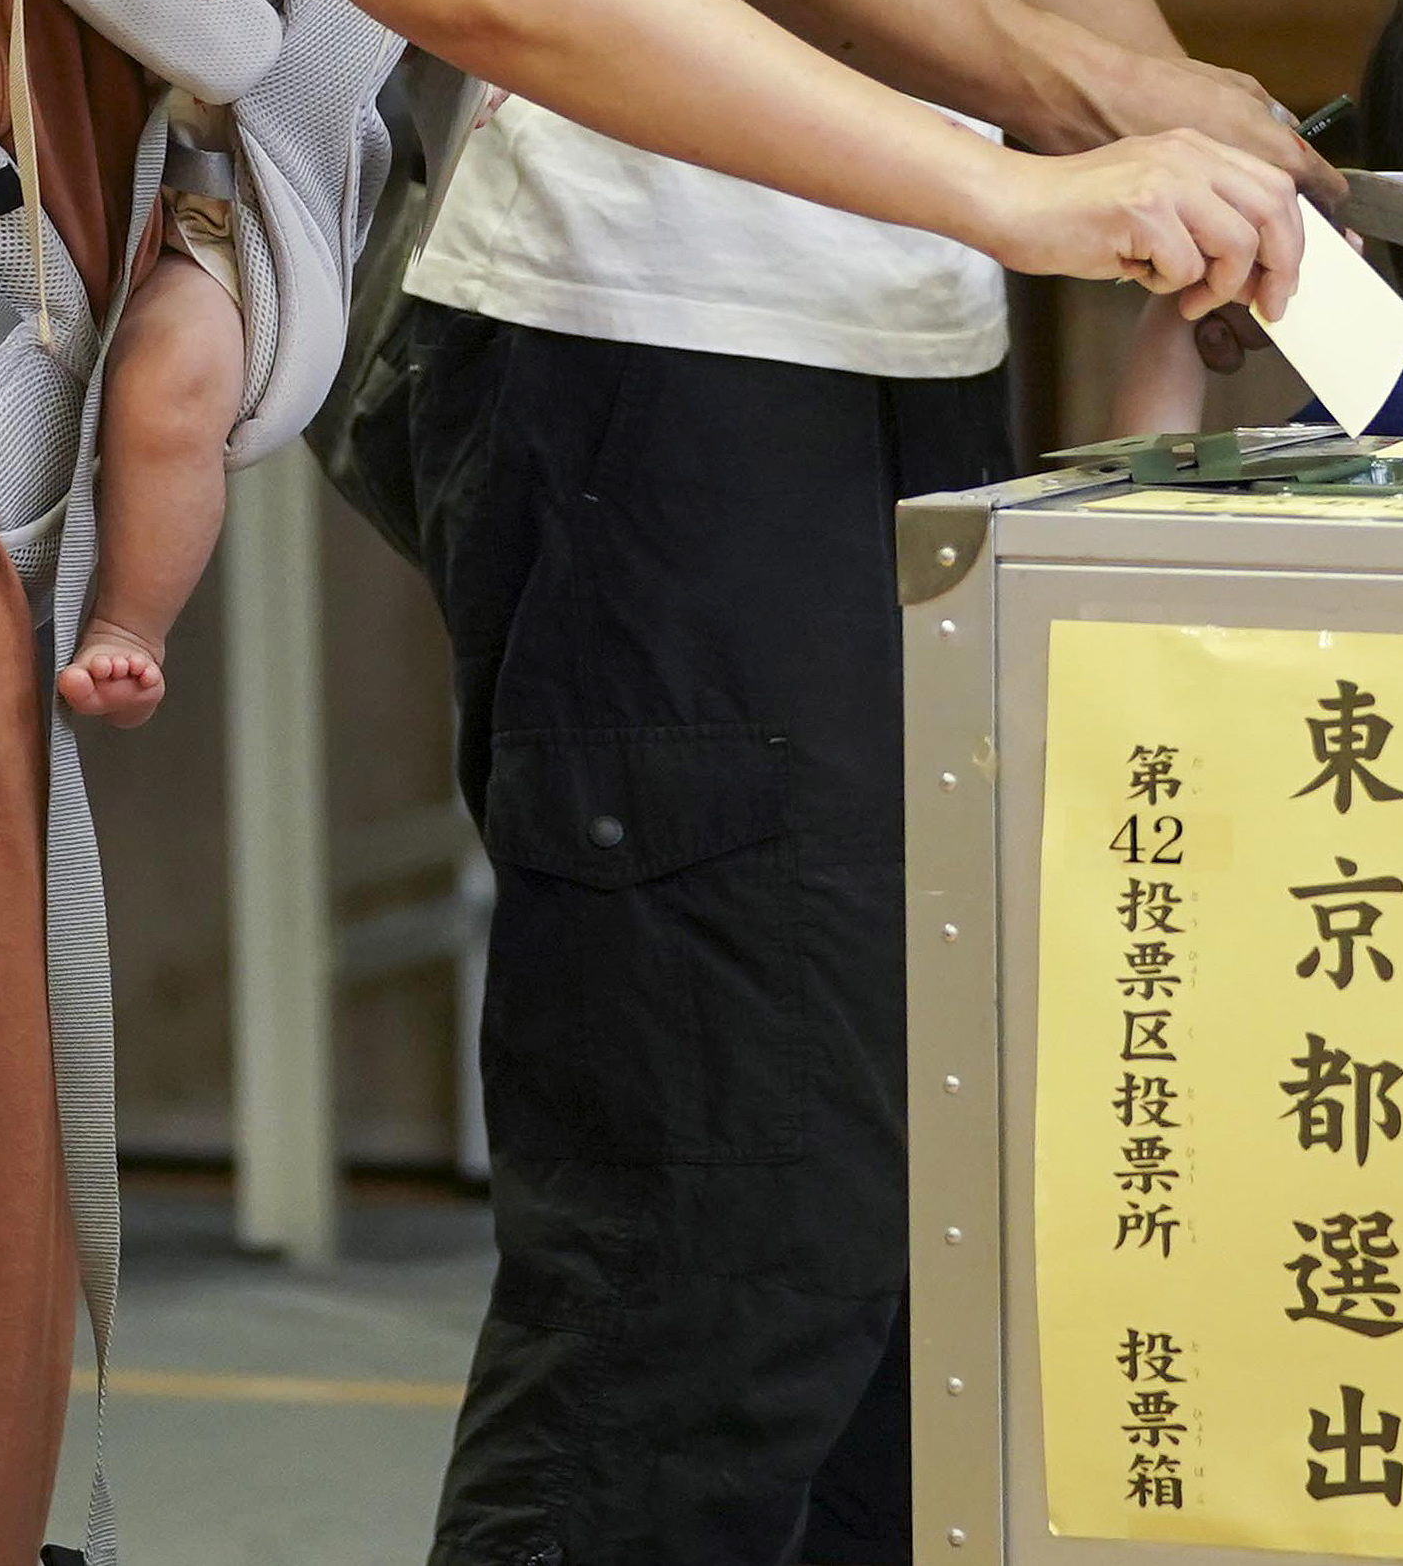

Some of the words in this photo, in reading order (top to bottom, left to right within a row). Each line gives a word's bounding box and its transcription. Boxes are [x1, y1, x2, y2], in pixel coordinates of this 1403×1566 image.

[1108, 744, 1186, 1259] 第42投票区投票所
[1116, 1328, 1188, 1510] 投票箱
